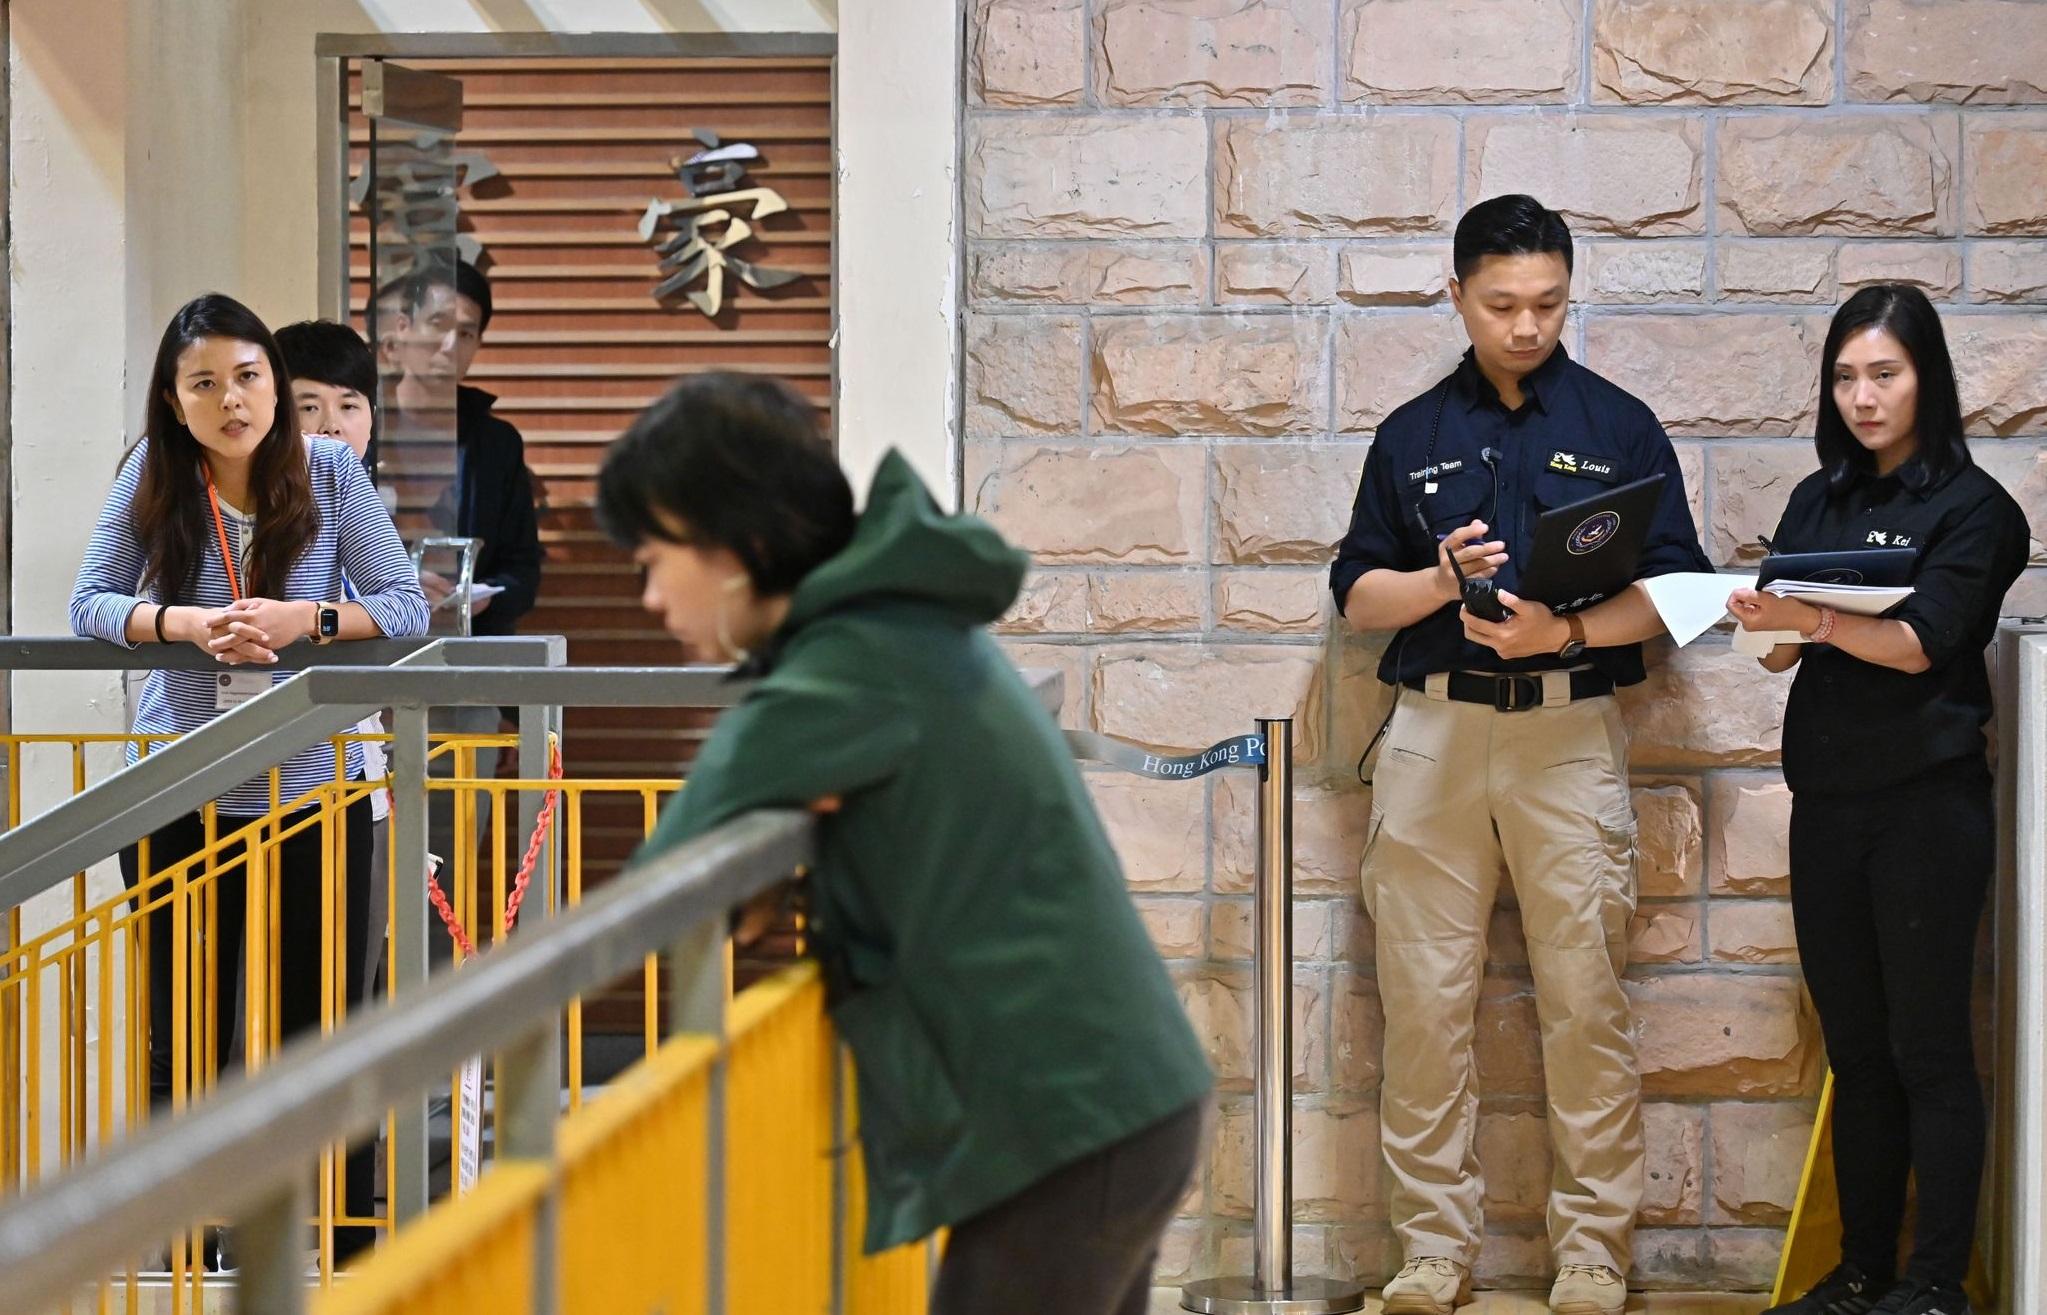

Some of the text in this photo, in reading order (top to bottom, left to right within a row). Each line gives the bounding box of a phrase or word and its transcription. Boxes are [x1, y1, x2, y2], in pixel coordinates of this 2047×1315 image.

[1409, 460, 1462, 480] Training Team
[1581, 460, 1611, 474] Louis
[1892, 535, 1912, 547] Kei
[1141, 754, 1195, 778] Hong
[1199, 745, 1239, 770] Kong
